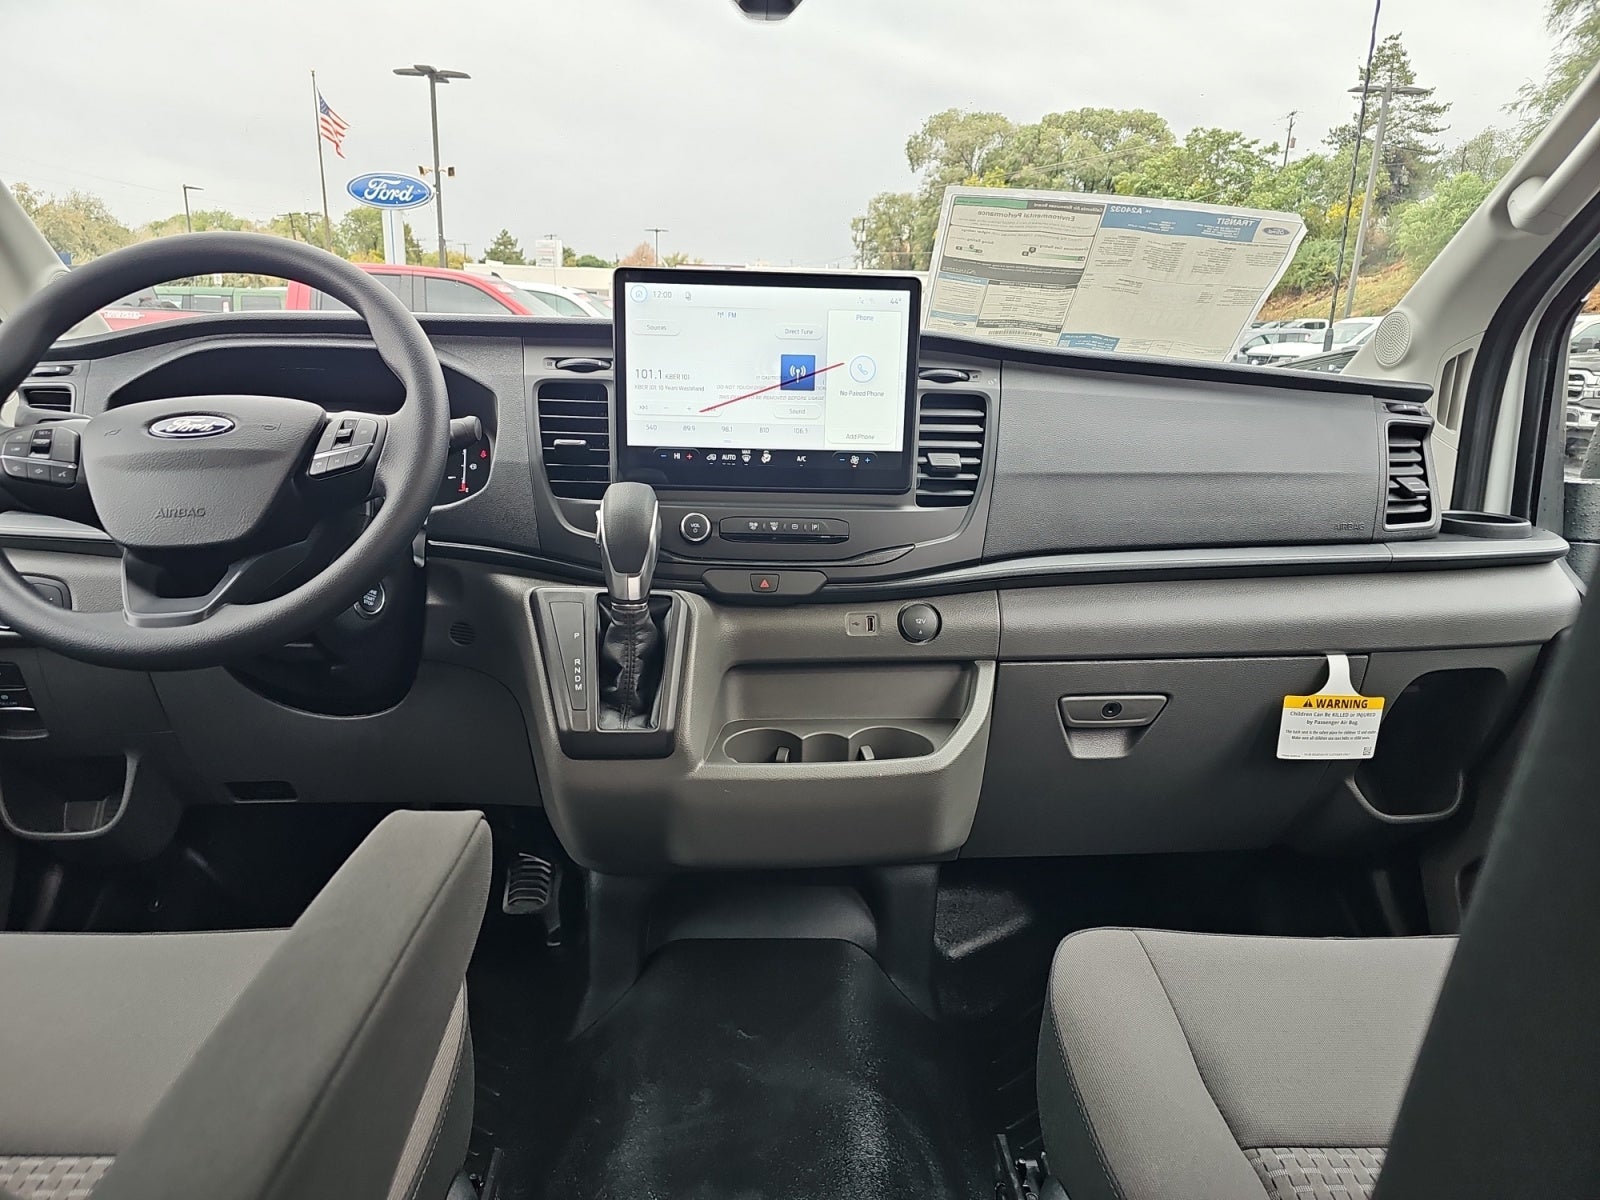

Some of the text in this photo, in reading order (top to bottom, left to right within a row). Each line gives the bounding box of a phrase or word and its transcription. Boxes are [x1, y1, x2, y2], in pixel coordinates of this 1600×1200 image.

[364, 178, 414, 201] Ford
[653, 291, 672, 299] 12:00
[635, 368, 662, 380] 101.1
[166, 418, 217, 433] Ford
[155, 506, 207, 520] AIRBAG
[1315, 699, 1368, 709] WARNING
